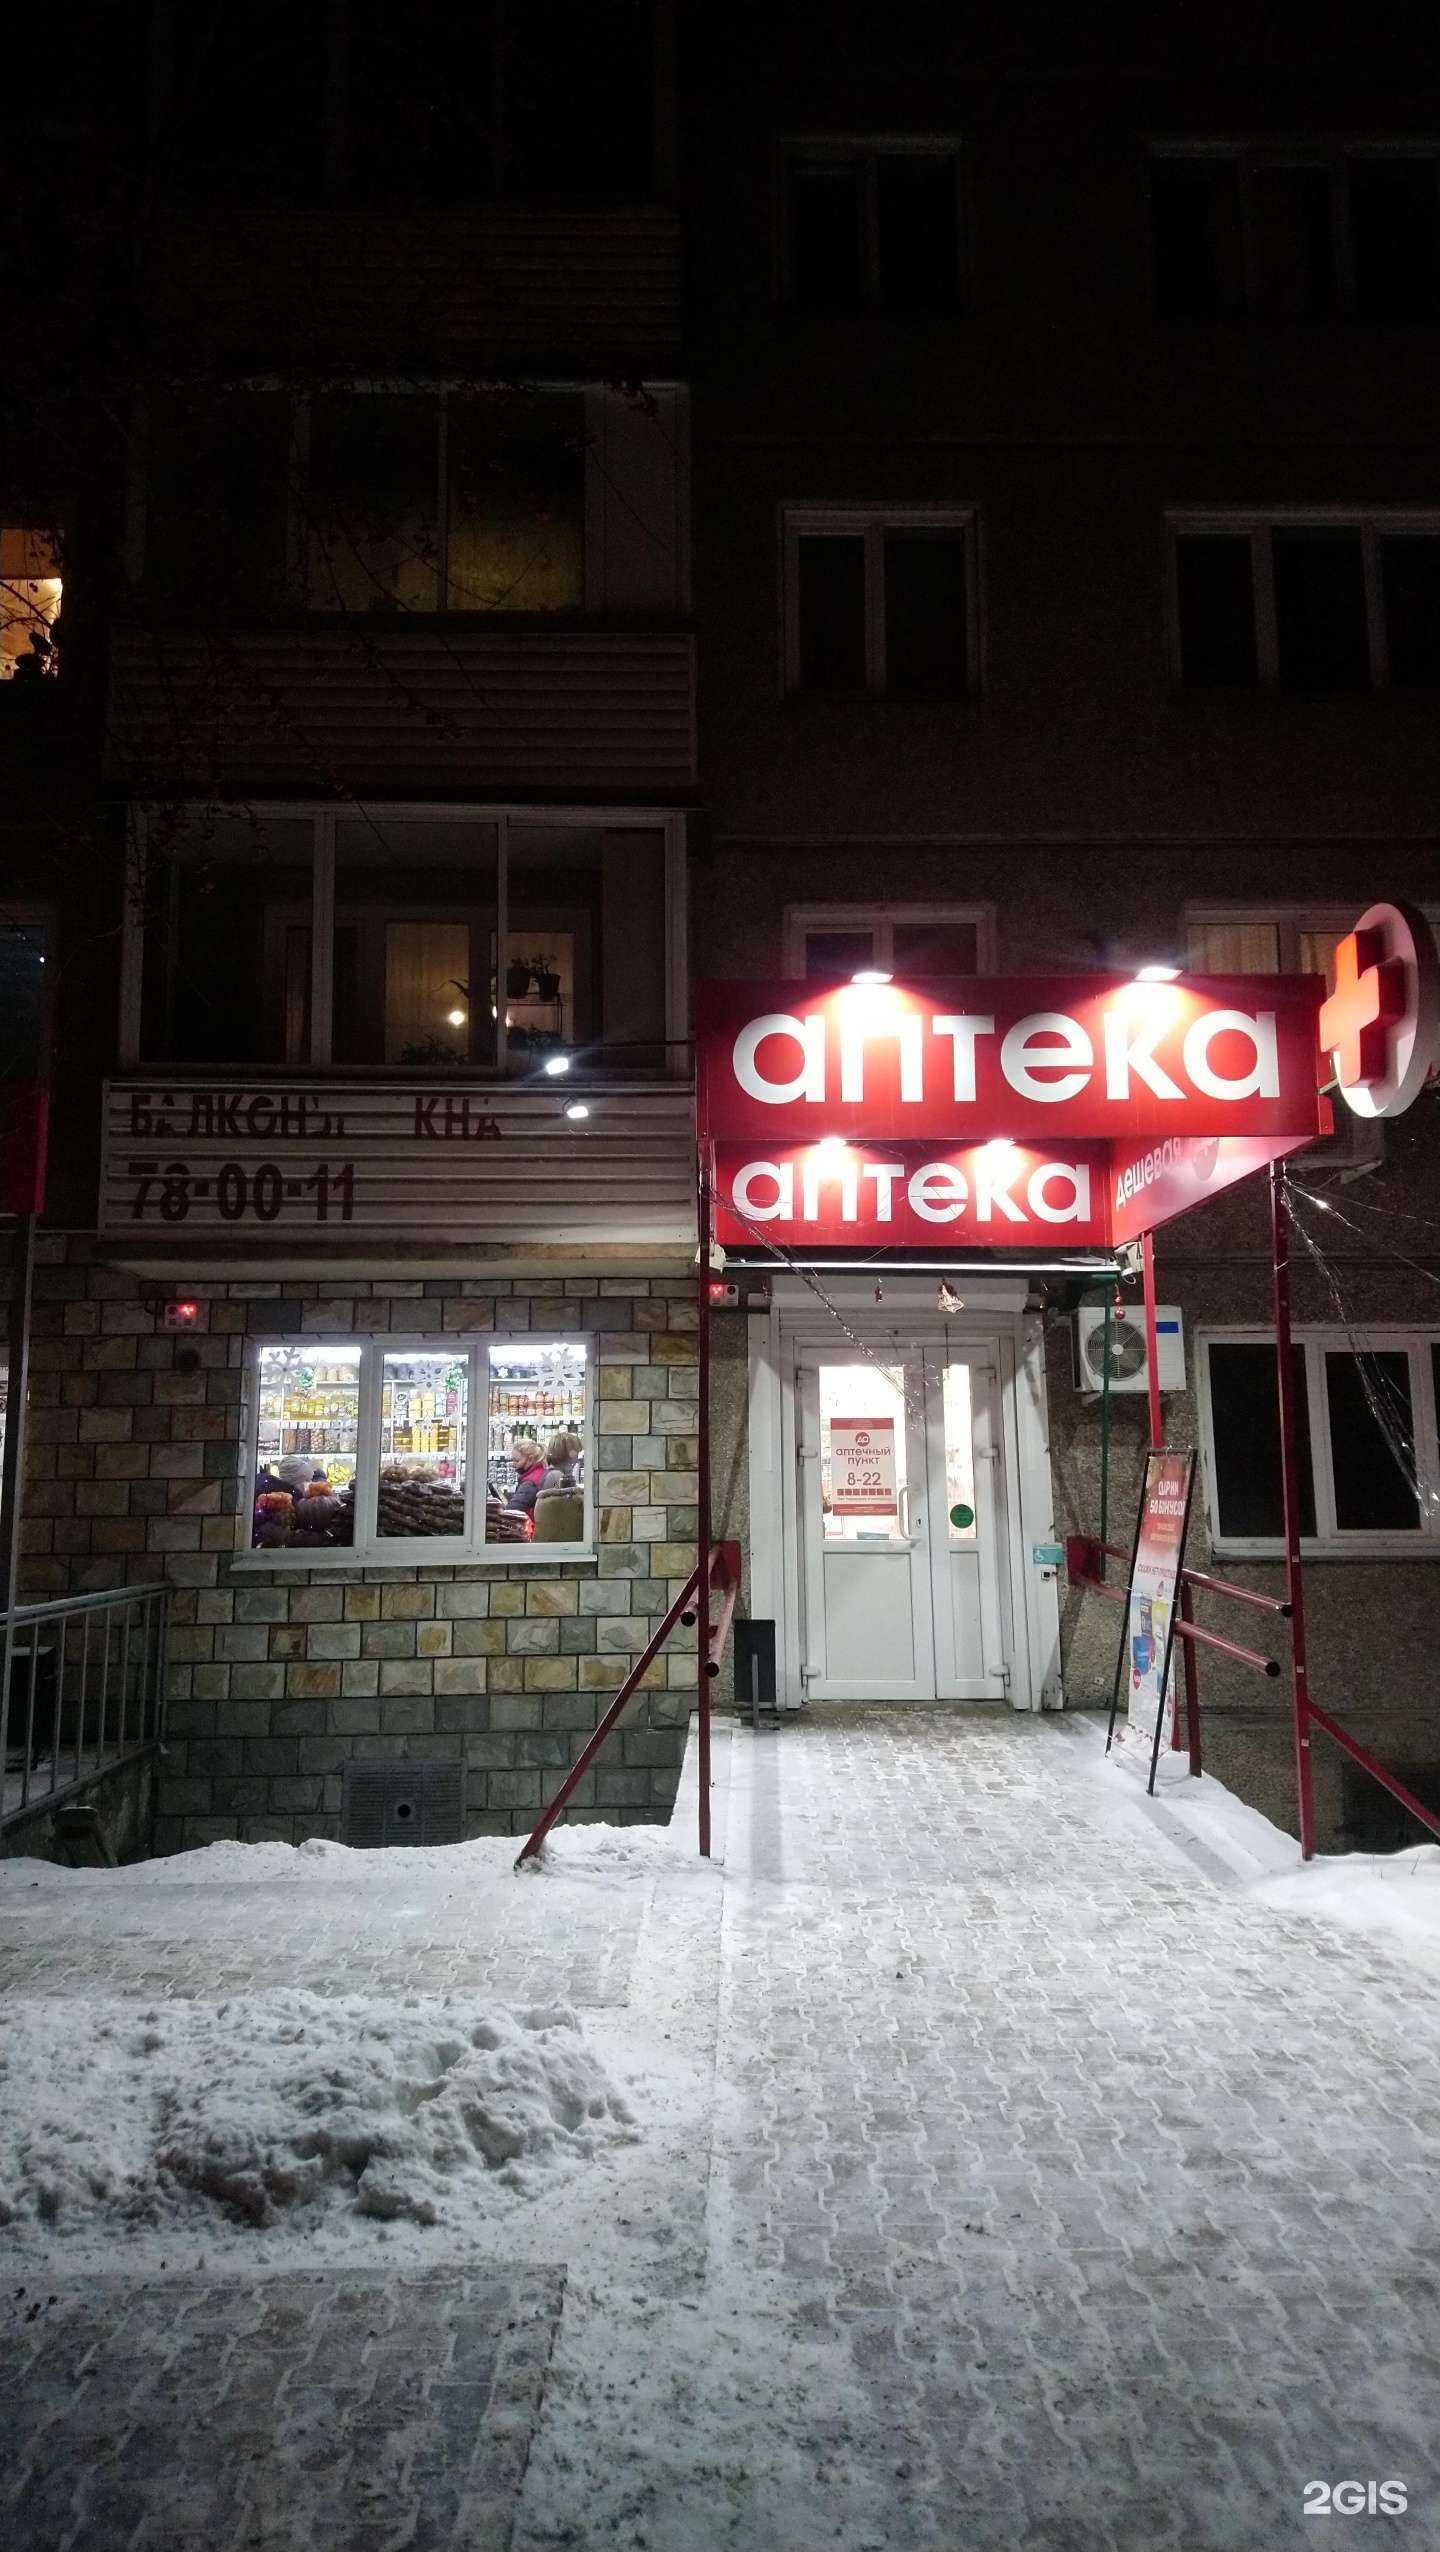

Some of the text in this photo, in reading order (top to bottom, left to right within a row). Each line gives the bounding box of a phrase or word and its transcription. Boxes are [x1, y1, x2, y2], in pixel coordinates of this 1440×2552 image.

[732, 1008, 1281, 1105] аптека
[128, 1162, 355, 1221] 78-00-11
[732, 1160, 1091, 1224] аптека
[835, 1446, 891, 1456] аптечный
[847, 1457, 880, 1467] пункт
[847, 1472, 881, 1486] 8-22
